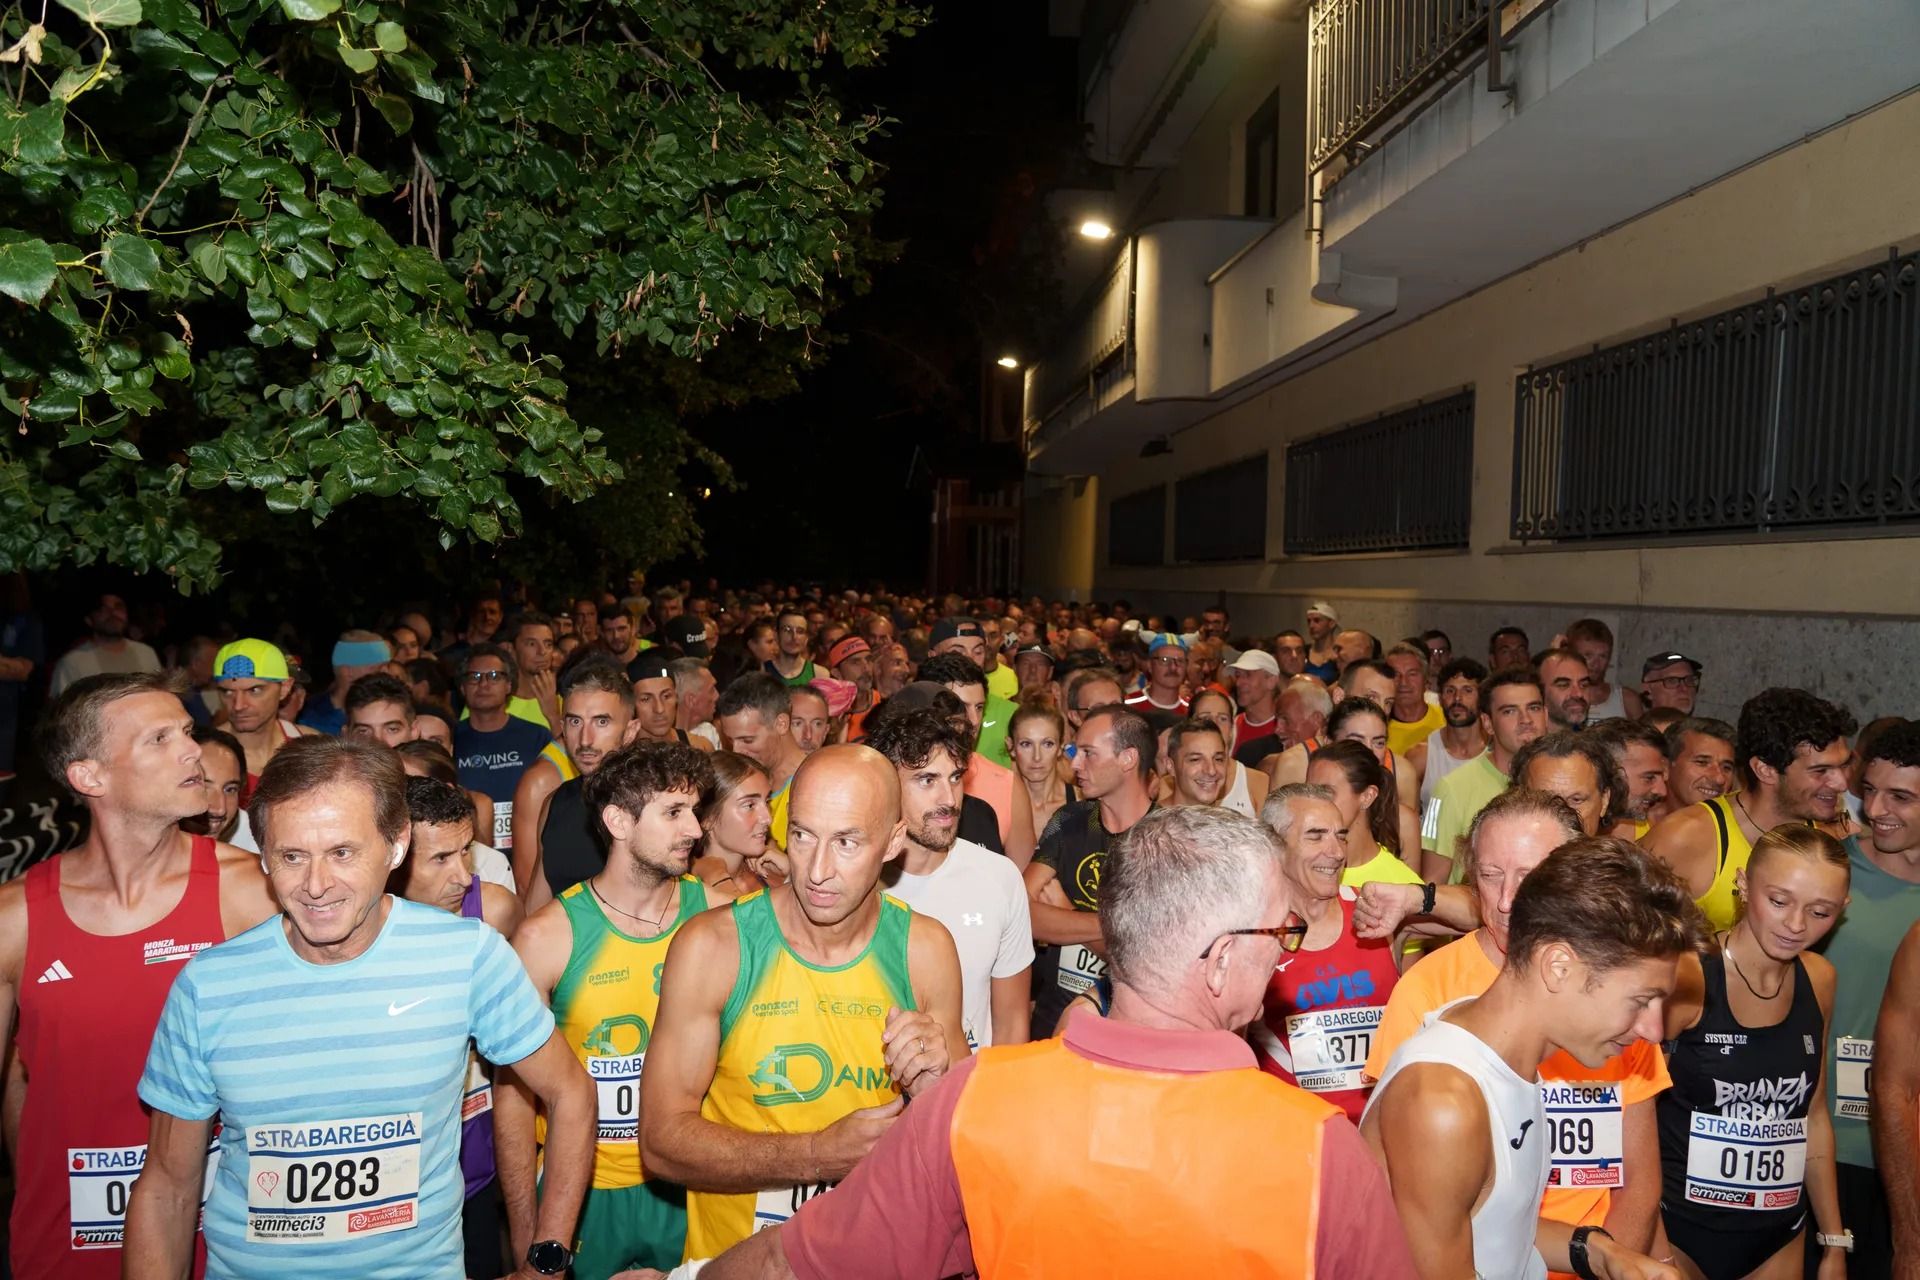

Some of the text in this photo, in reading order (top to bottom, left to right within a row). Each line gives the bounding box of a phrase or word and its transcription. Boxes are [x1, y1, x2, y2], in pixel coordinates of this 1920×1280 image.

[458, 751, 520, 768] MOVING
[144, 939, 175, 951] MONZA
[144, 942, 213, 958] MARATHON TEAM
[1296, 970, 1375, 1010] AVIS
[1704, 1033, 1734, 1044] SYSTEM
[1713, 1071, 1812, 1107] BRIANZA
[255, 1119, 416, 1148] STRABAREGGIA
[1695, 1116, 1804, 1139] STRABAREGGIA
[1720, 1147, 1785, 1182] 0158
[286, 1156, 380, 1204] 0283
[254, 1215, 326, 1231] emmeci3
